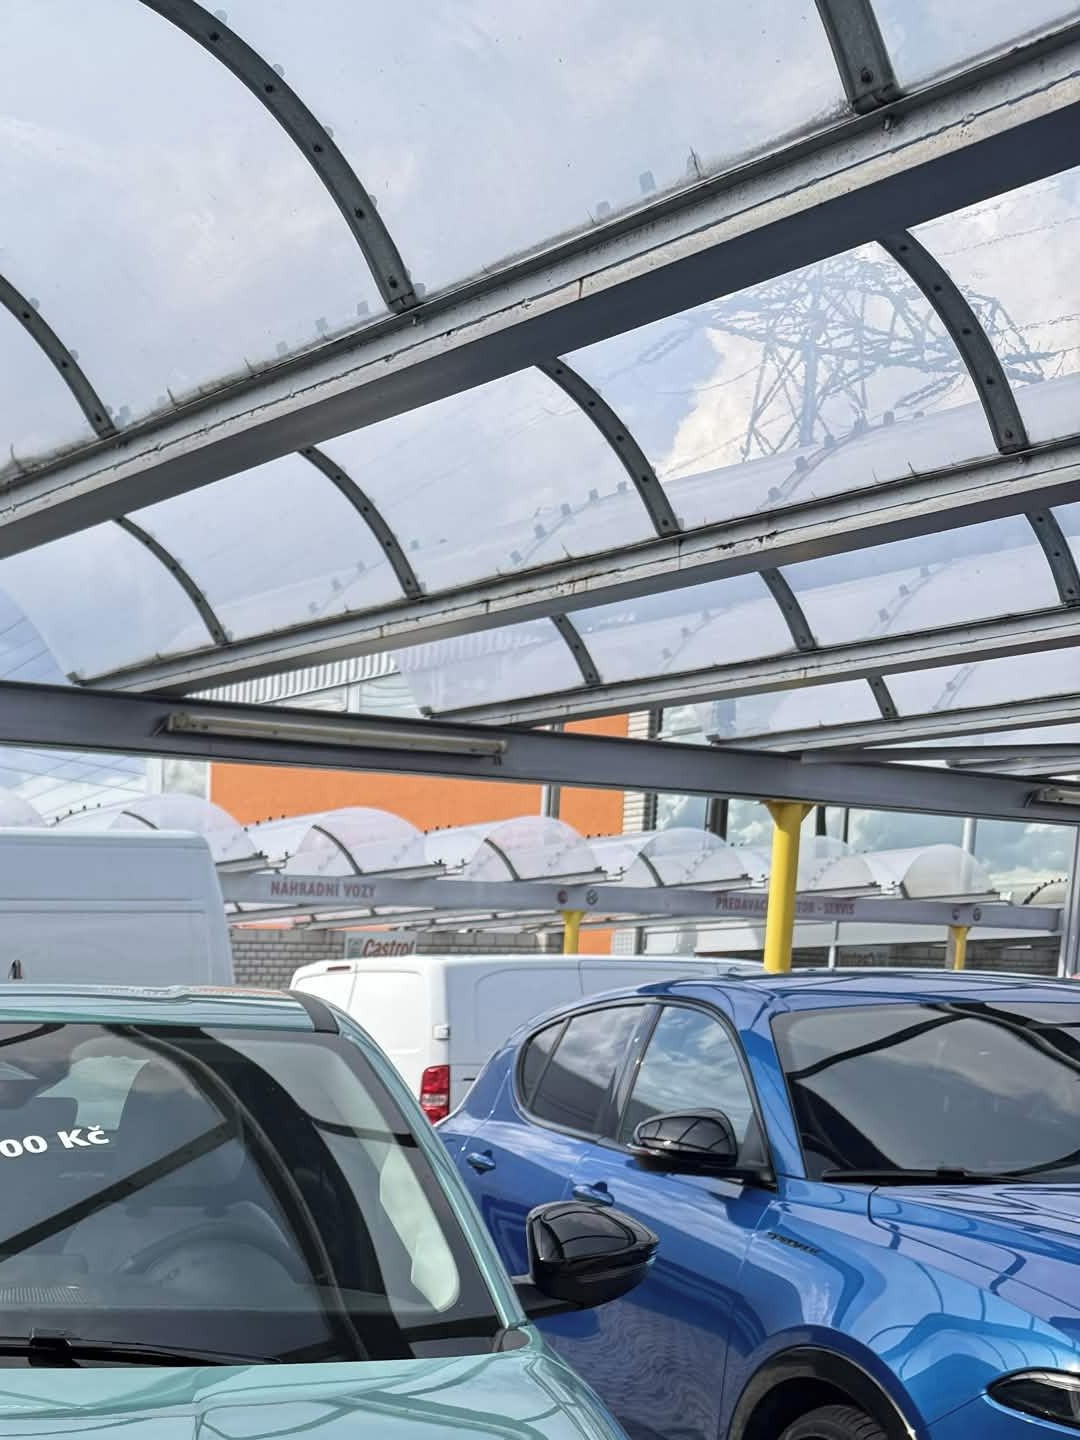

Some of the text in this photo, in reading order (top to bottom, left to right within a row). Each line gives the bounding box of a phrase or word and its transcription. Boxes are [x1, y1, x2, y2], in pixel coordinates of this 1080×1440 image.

[344, 883, 376, 897] VOZY
[363, 938, 415, 957] Castrol
[57, 1125, 110, 1149] Kč
